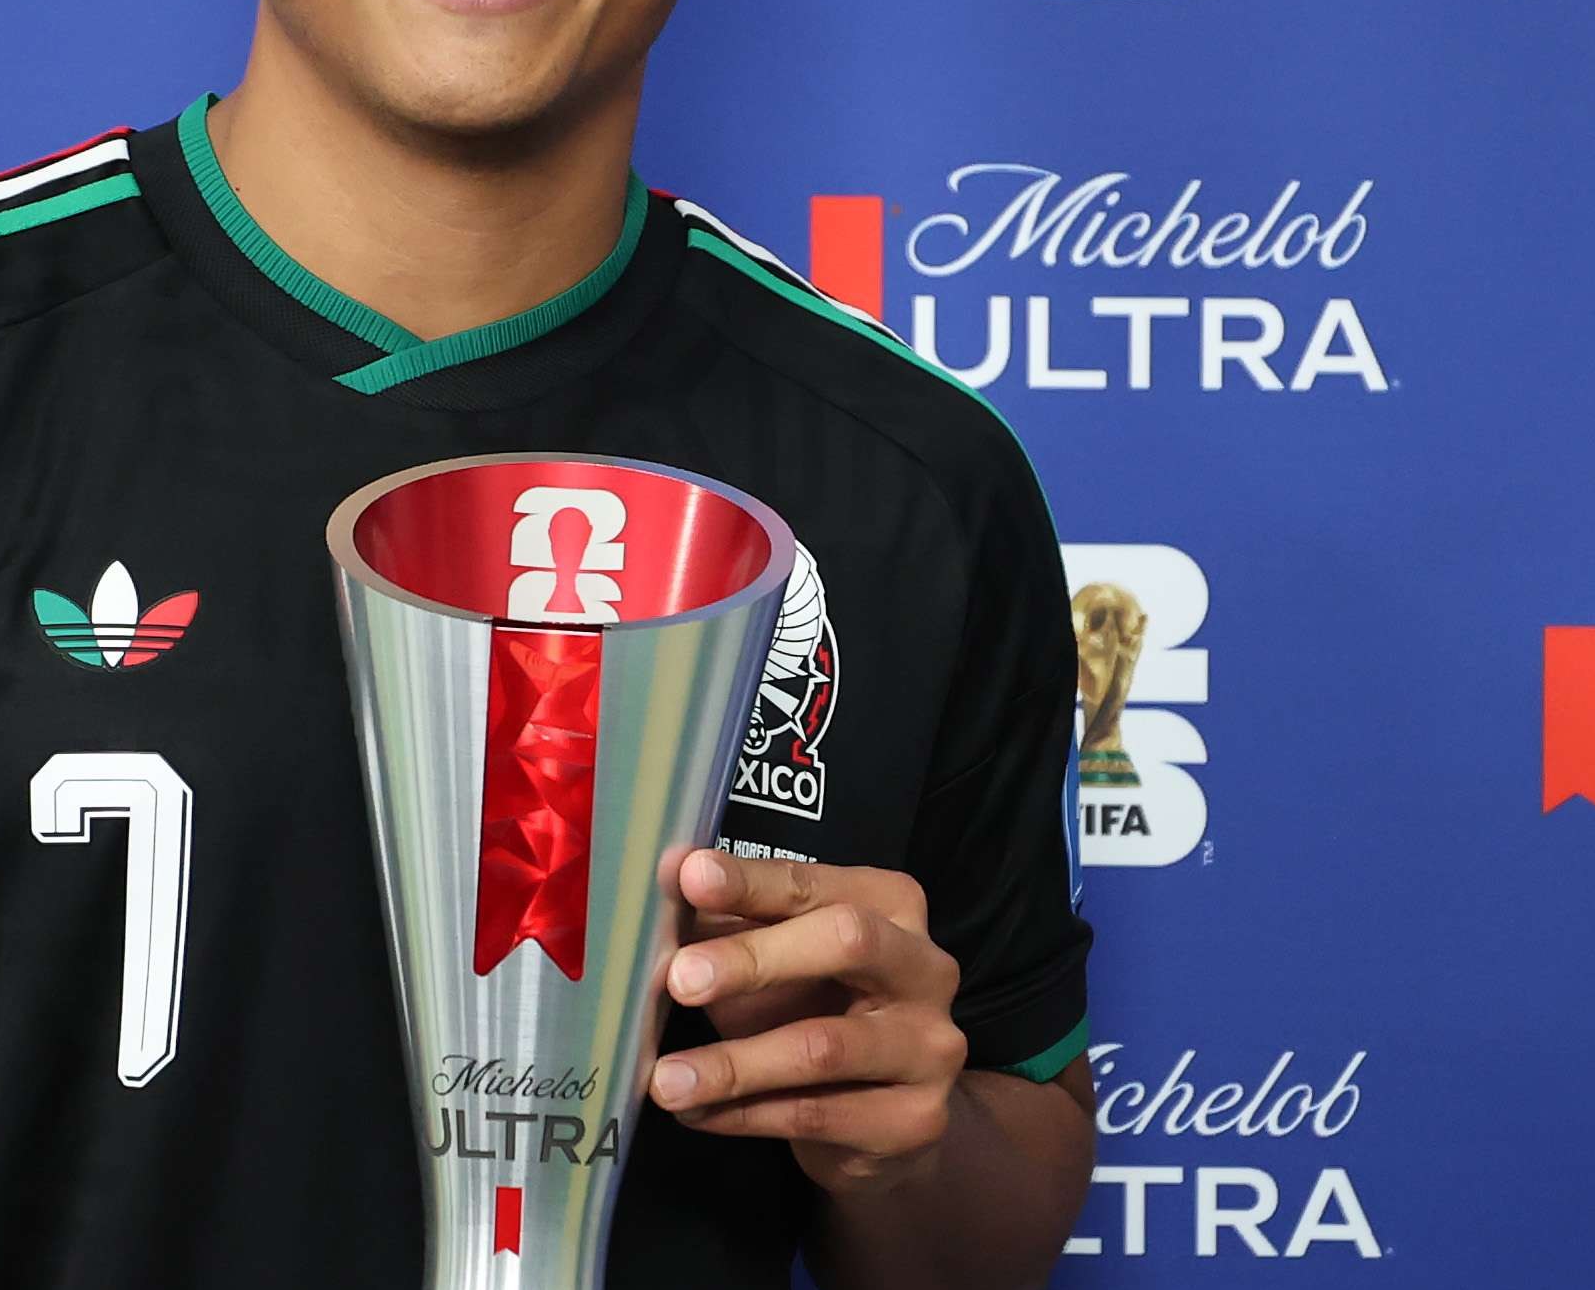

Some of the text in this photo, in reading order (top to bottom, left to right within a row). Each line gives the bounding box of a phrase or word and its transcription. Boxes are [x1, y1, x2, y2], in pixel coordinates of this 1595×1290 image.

[906, 164, 1373, 276] Michelob
[734, 759, 819, 807] XICO
[1080, 804, 1151, 837] IFA
[30, 752, 193, 1088] 7
[432, 1054, 600, 1101] Michelob
[1088, 1043, 1367, 1138] chelob
[1063, 1166, 1381, 1258] TRA
